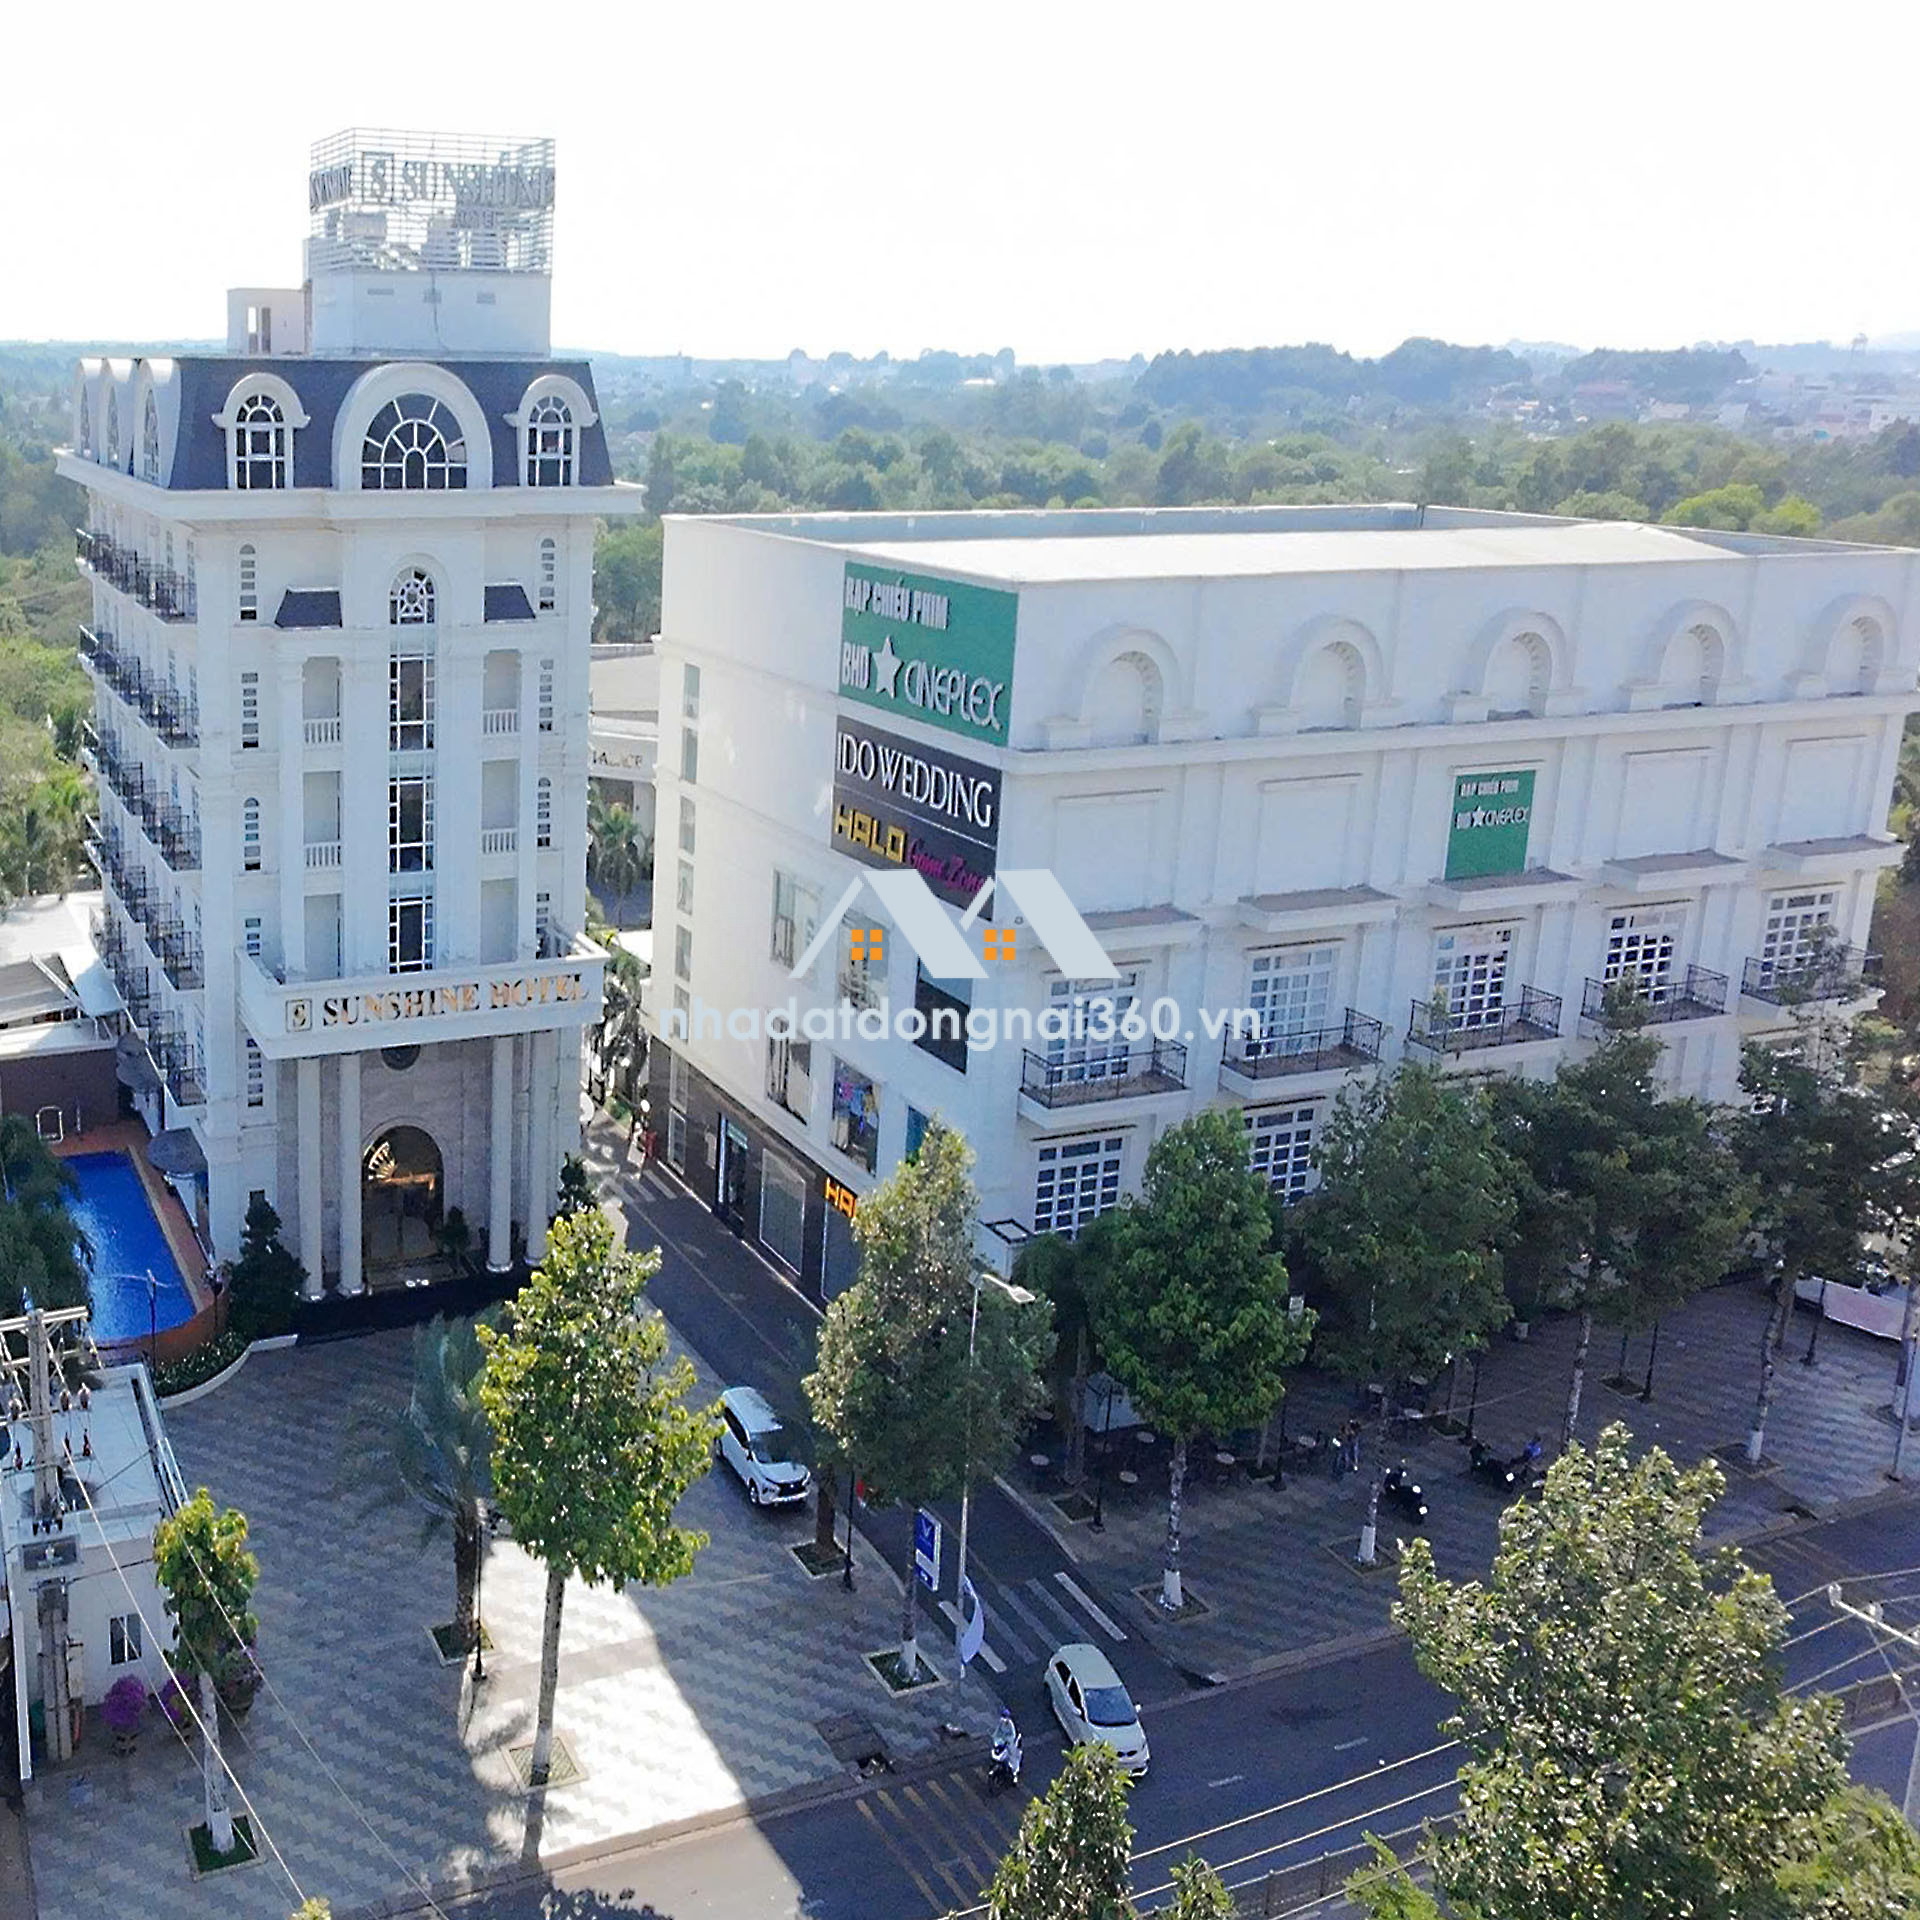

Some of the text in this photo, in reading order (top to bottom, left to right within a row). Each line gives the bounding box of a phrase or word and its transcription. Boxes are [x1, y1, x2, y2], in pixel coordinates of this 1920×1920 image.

[905, 659, 1004, 732] CINEPLEX
[835, 804, 907, 865] HALO
[323, 973, 589, 1026] SUNSHINE HOTEL
